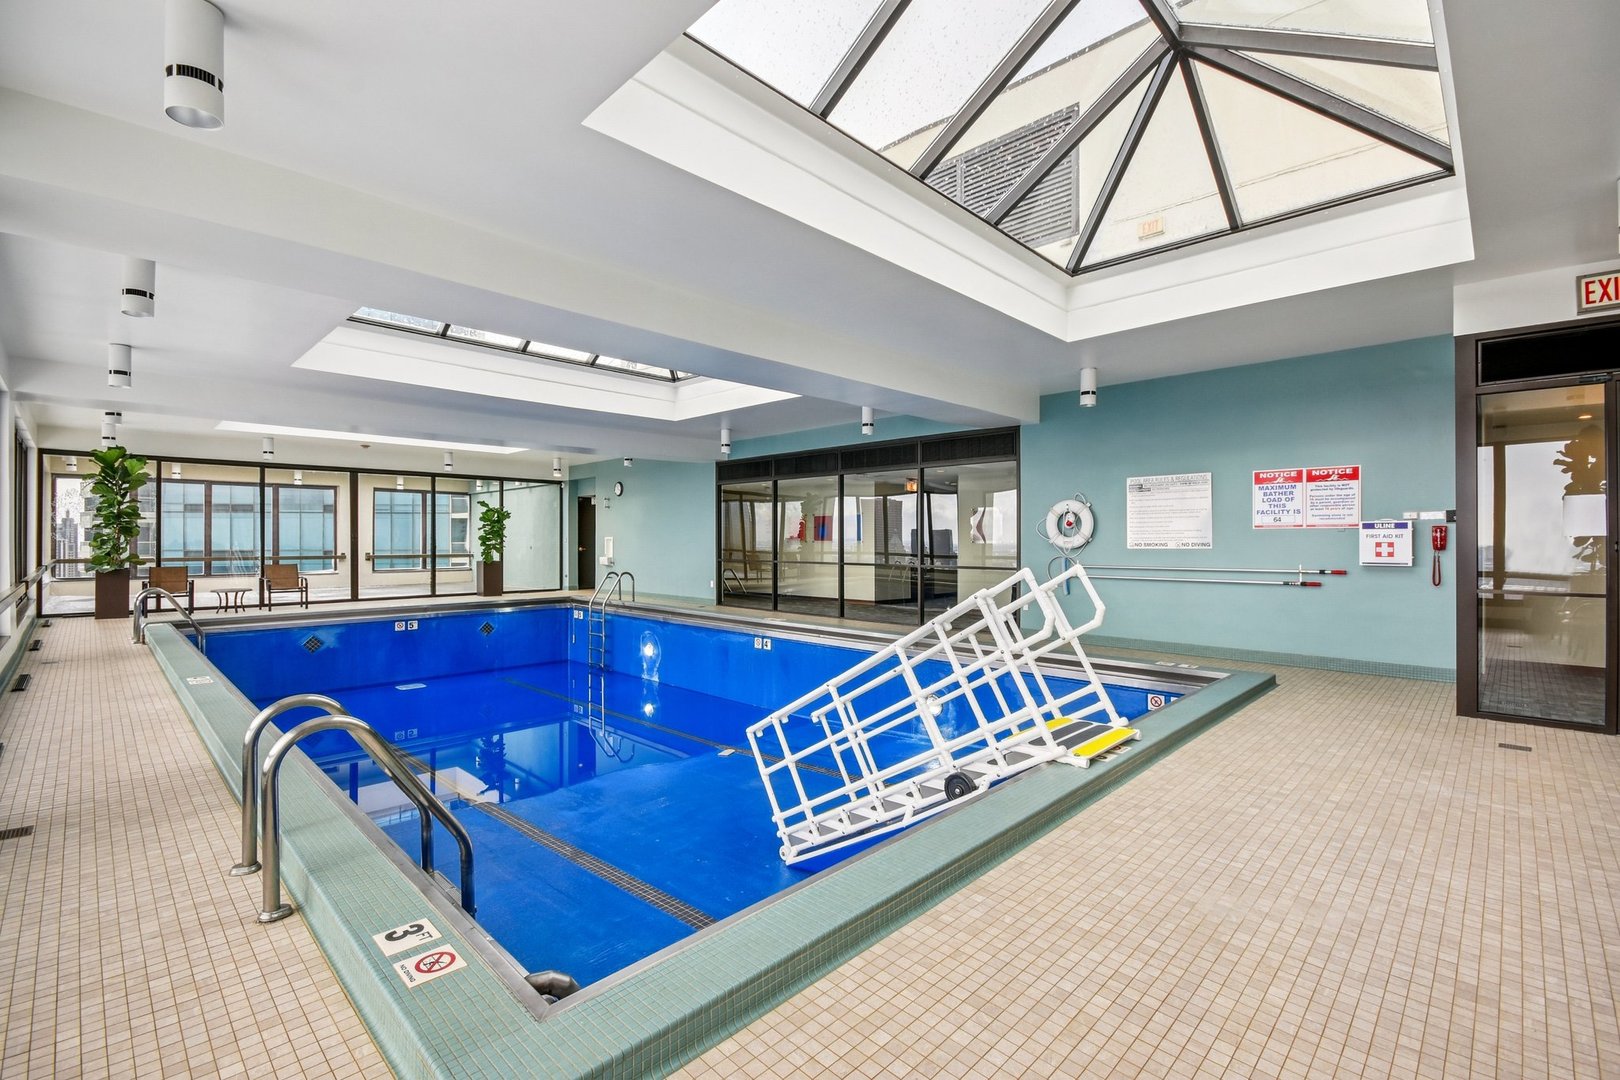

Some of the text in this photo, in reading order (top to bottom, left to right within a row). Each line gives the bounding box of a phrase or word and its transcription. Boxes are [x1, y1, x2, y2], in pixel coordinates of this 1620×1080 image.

[1585, 276, 1620, 305] EXI
[1312, 468, 1353, 476] NOTICE
[384, 923, 433, 942] 3 FT
